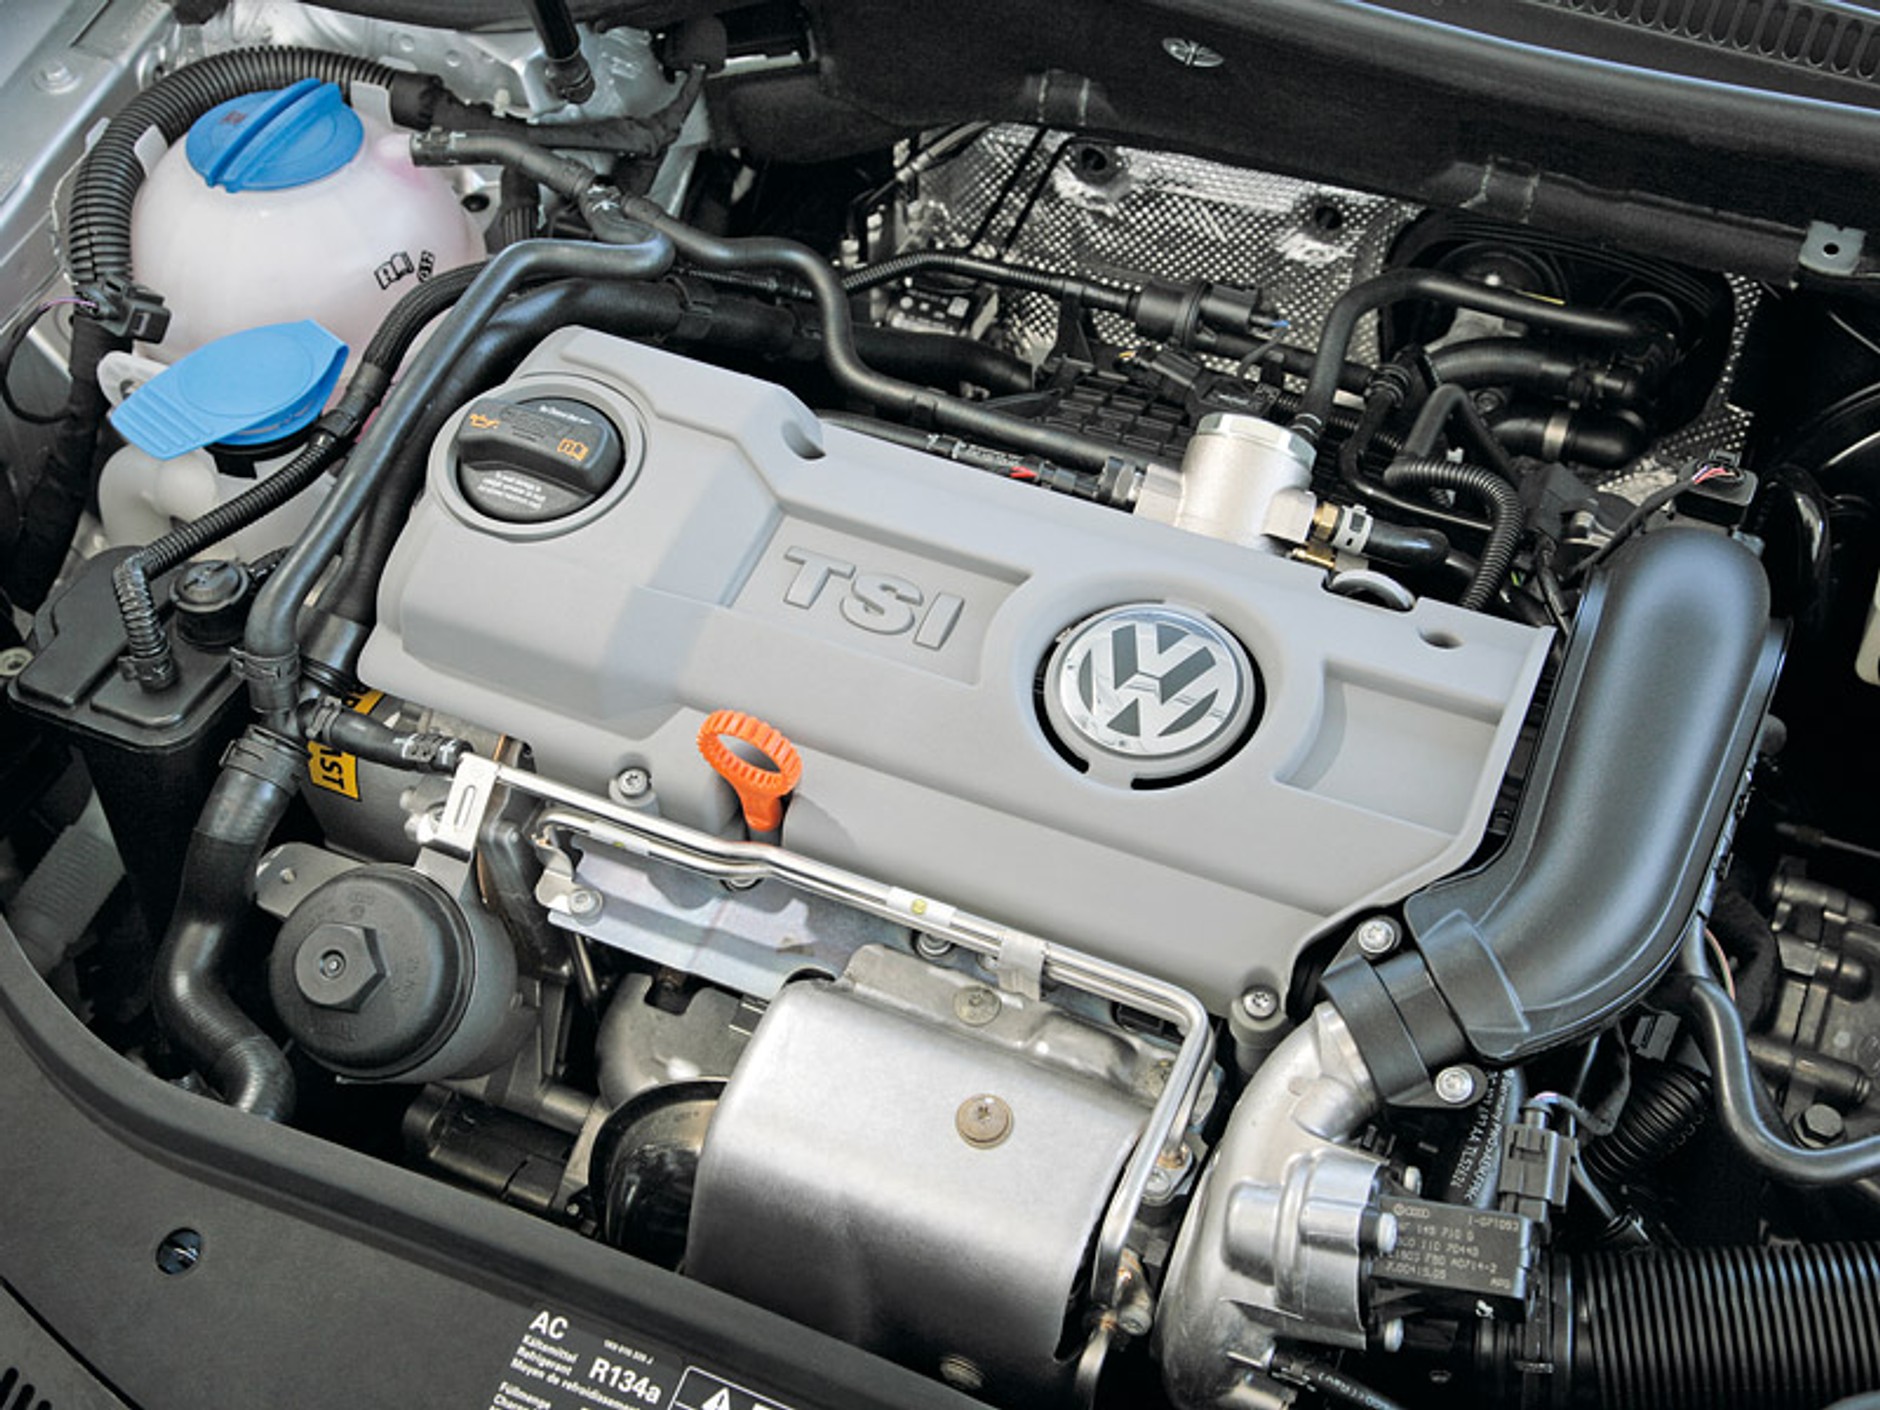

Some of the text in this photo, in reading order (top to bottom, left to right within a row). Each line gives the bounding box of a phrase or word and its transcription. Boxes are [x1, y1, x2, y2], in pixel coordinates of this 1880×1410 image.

[783, 546, 966, 651] TSI
[529, 1310, 569, 1340] AC
[589, 1356, 662, 1404] R134a
